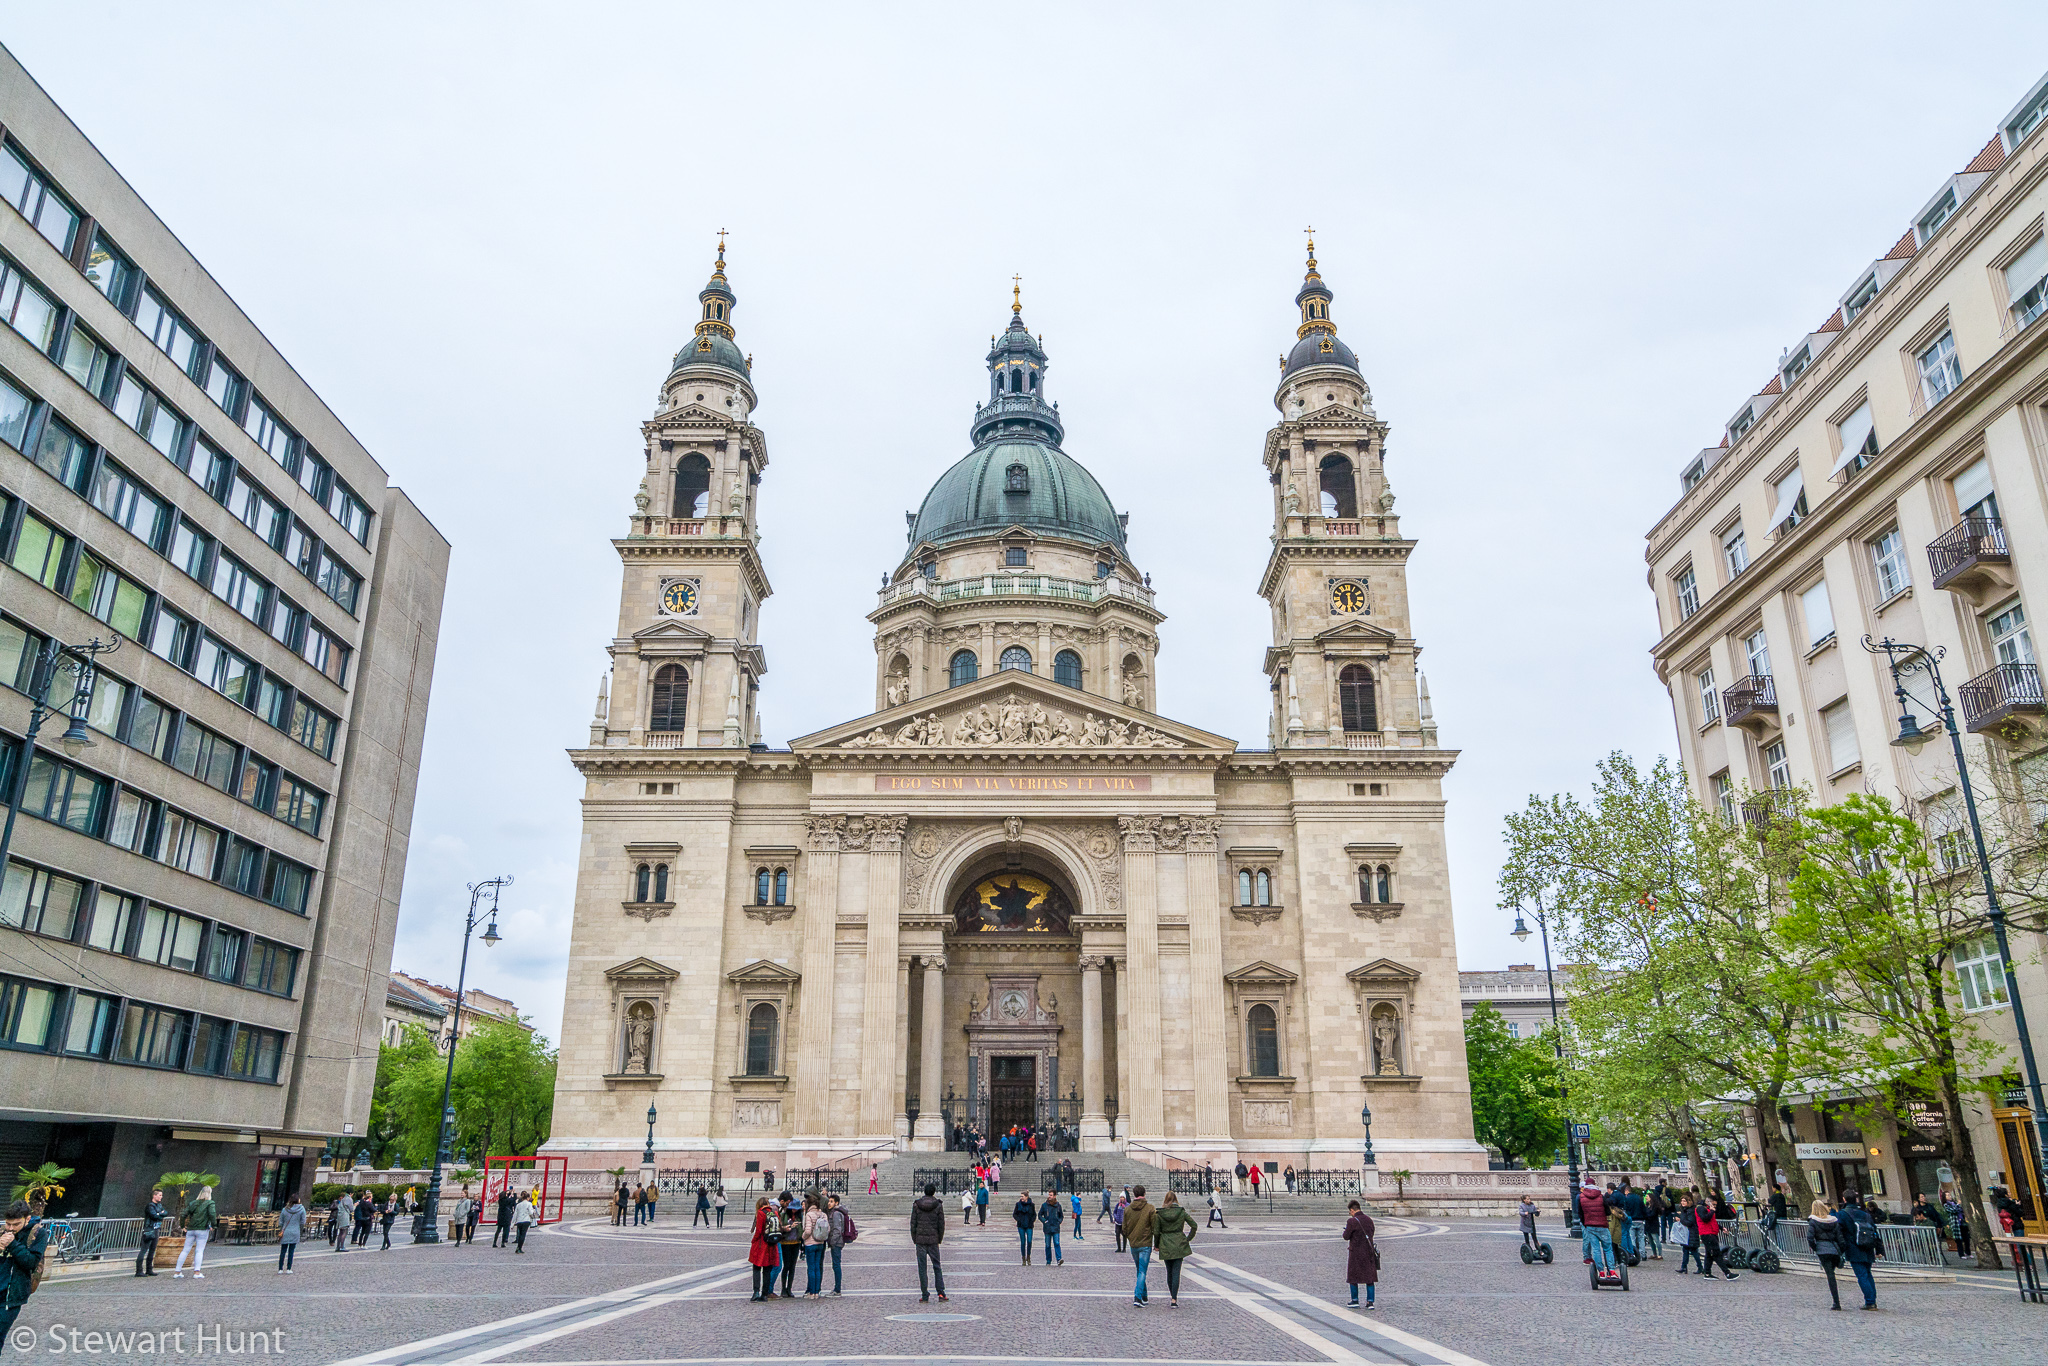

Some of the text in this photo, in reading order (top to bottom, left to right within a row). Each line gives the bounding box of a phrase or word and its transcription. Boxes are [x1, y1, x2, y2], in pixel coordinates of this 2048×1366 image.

[891, 777, 1135, 790] EGO SUM VIA VERITAS ET VITA
[1812, 1146, 1860, 1155] Company
